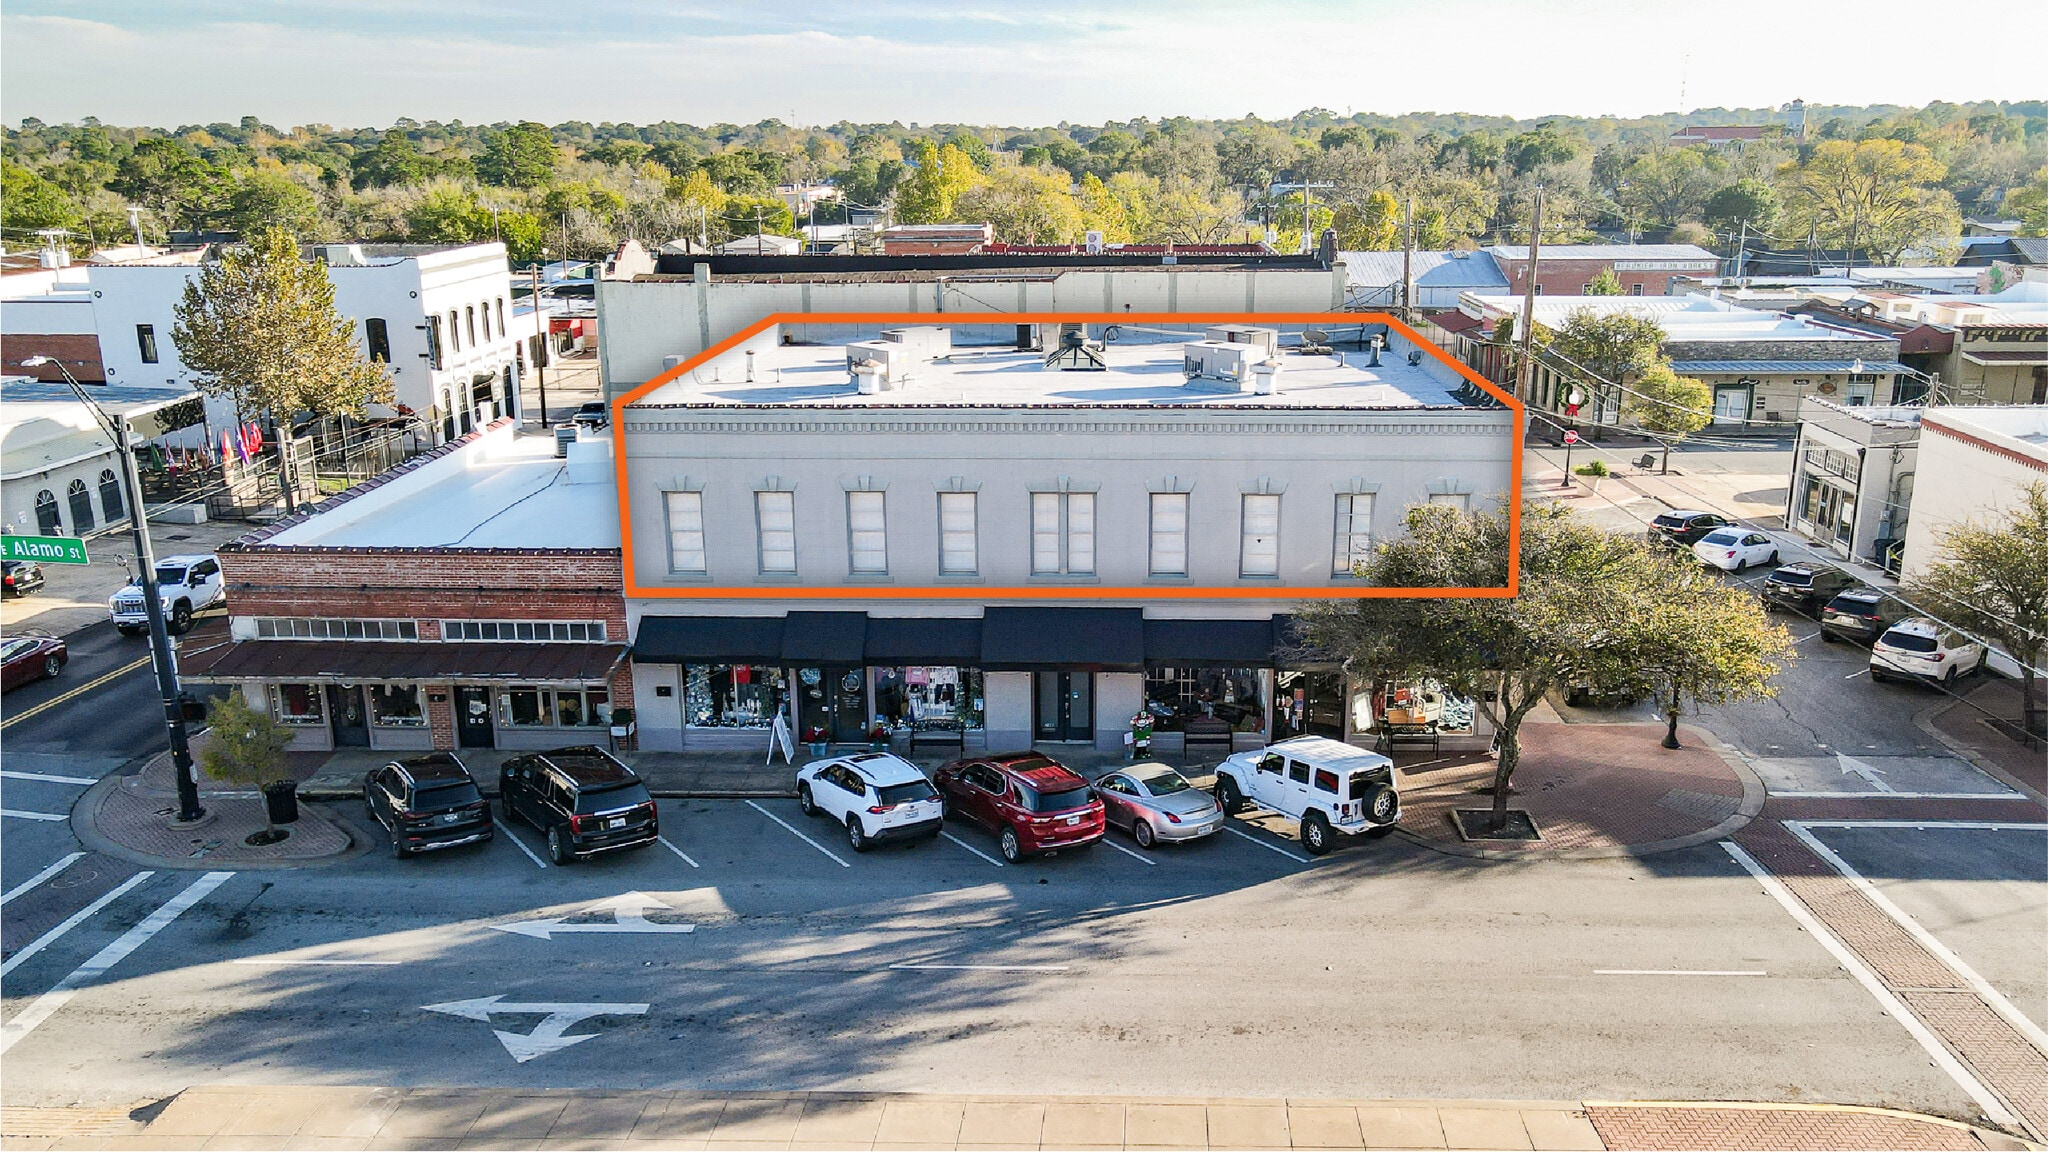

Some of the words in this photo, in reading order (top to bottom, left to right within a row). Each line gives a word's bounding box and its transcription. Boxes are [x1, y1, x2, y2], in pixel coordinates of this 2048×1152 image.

[1659, 262, 1678, 270] IRON
[1683, 262, 1708, 270] WORKS
[14, 540, 64, 557] Alamo
[69, 547, 81, 559] St
